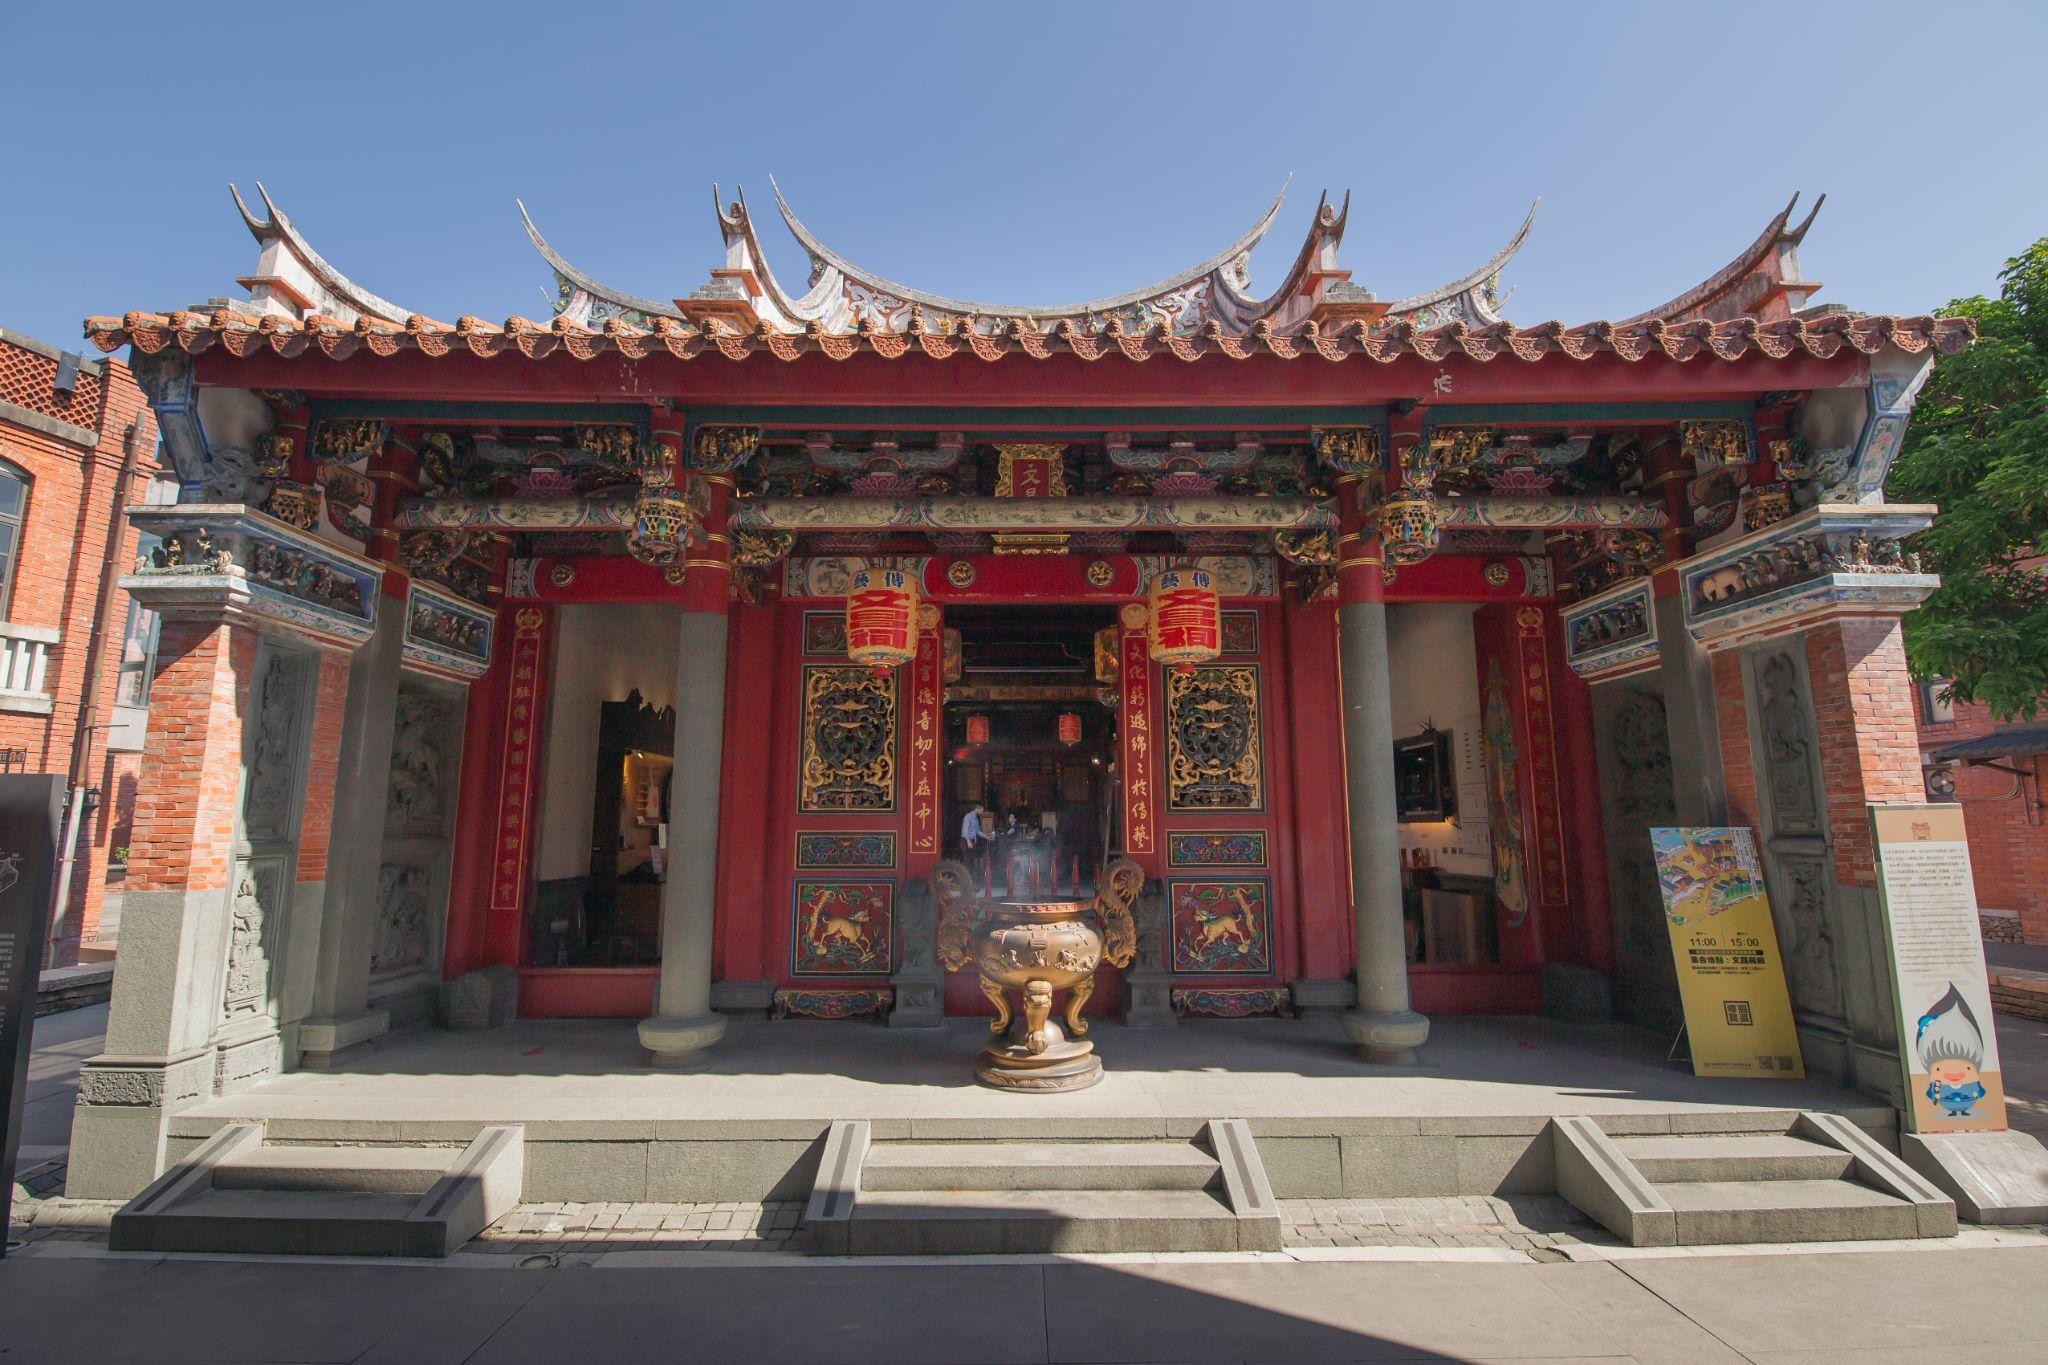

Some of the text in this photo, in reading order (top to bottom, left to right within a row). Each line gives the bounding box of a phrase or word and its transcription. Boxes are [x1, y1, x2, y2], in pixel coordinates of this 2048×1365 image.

[850, 589, 910, 650] 文昌祠
[1157, 589, 1217, 650] 文昌祠
[1689, 937, 1717, 947] 11:00
[1730, 938, 1759, 947] 15:00
